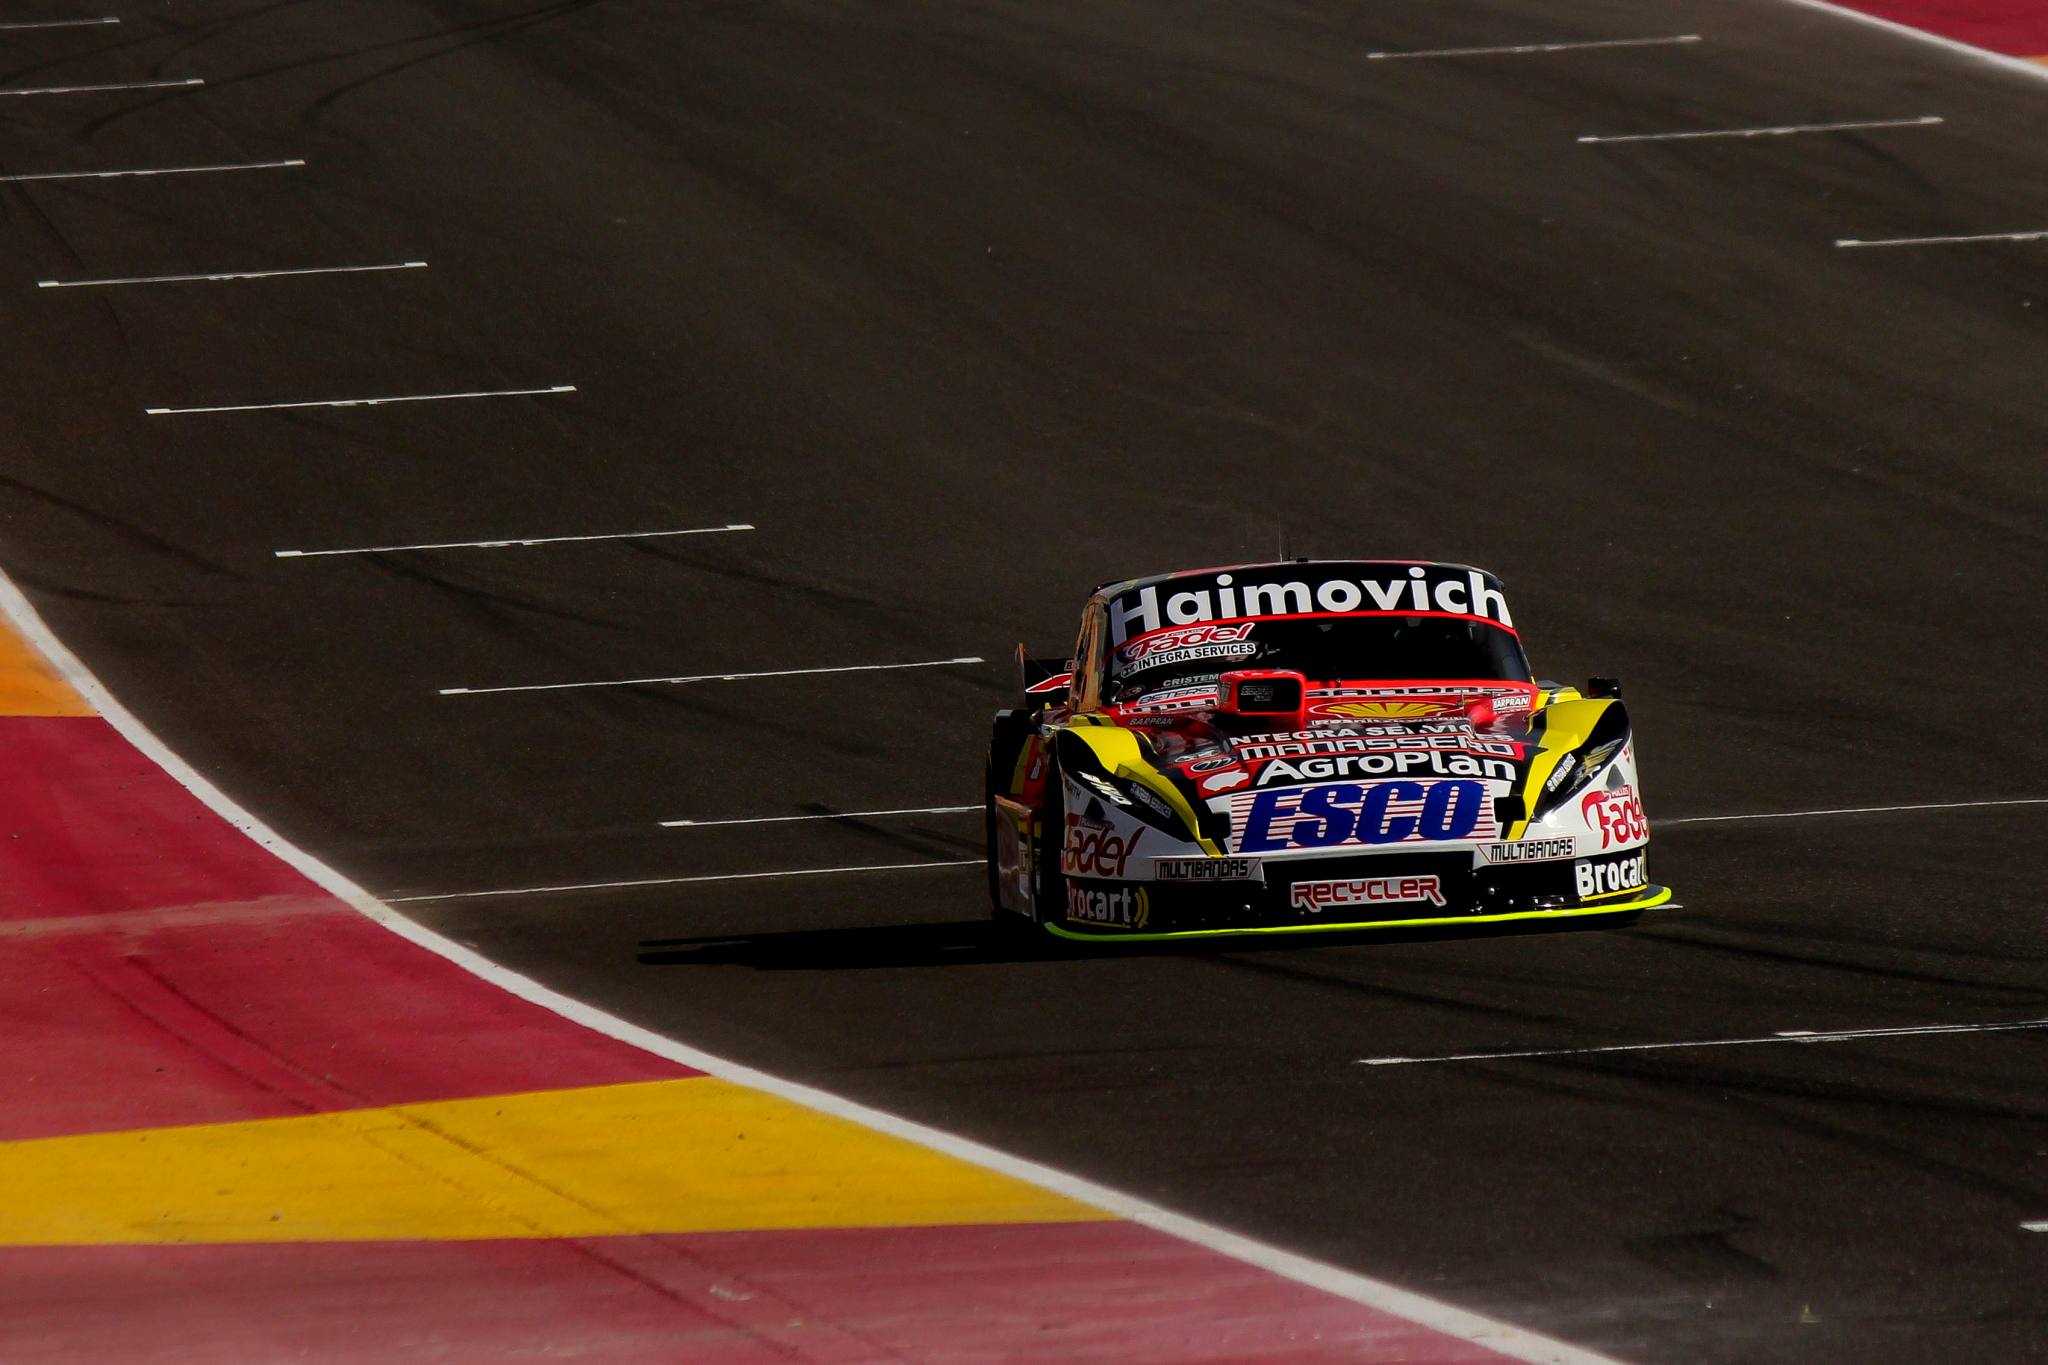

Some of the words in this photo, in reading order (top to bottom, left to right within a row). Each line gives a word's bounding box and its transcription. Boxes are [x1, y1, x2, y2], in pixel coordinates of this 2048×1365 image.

[1111, 567, 1512, 647] Haimovich
[1127, 622, 1255, 661] Fadel
[1138, 650, 1191, 670] INTEGRA
[1195, 643, 1255, 658] SERVICES
[1240, 780, 1485, 852] ESCO
[1062, 813, 1146, 877] adel
[1491, 838, 1573, 861] MULTIBANDAS
[1159, 859, 1249, 879] MULTIBANDAS
[1066, 877, 1131, 923] rocart
